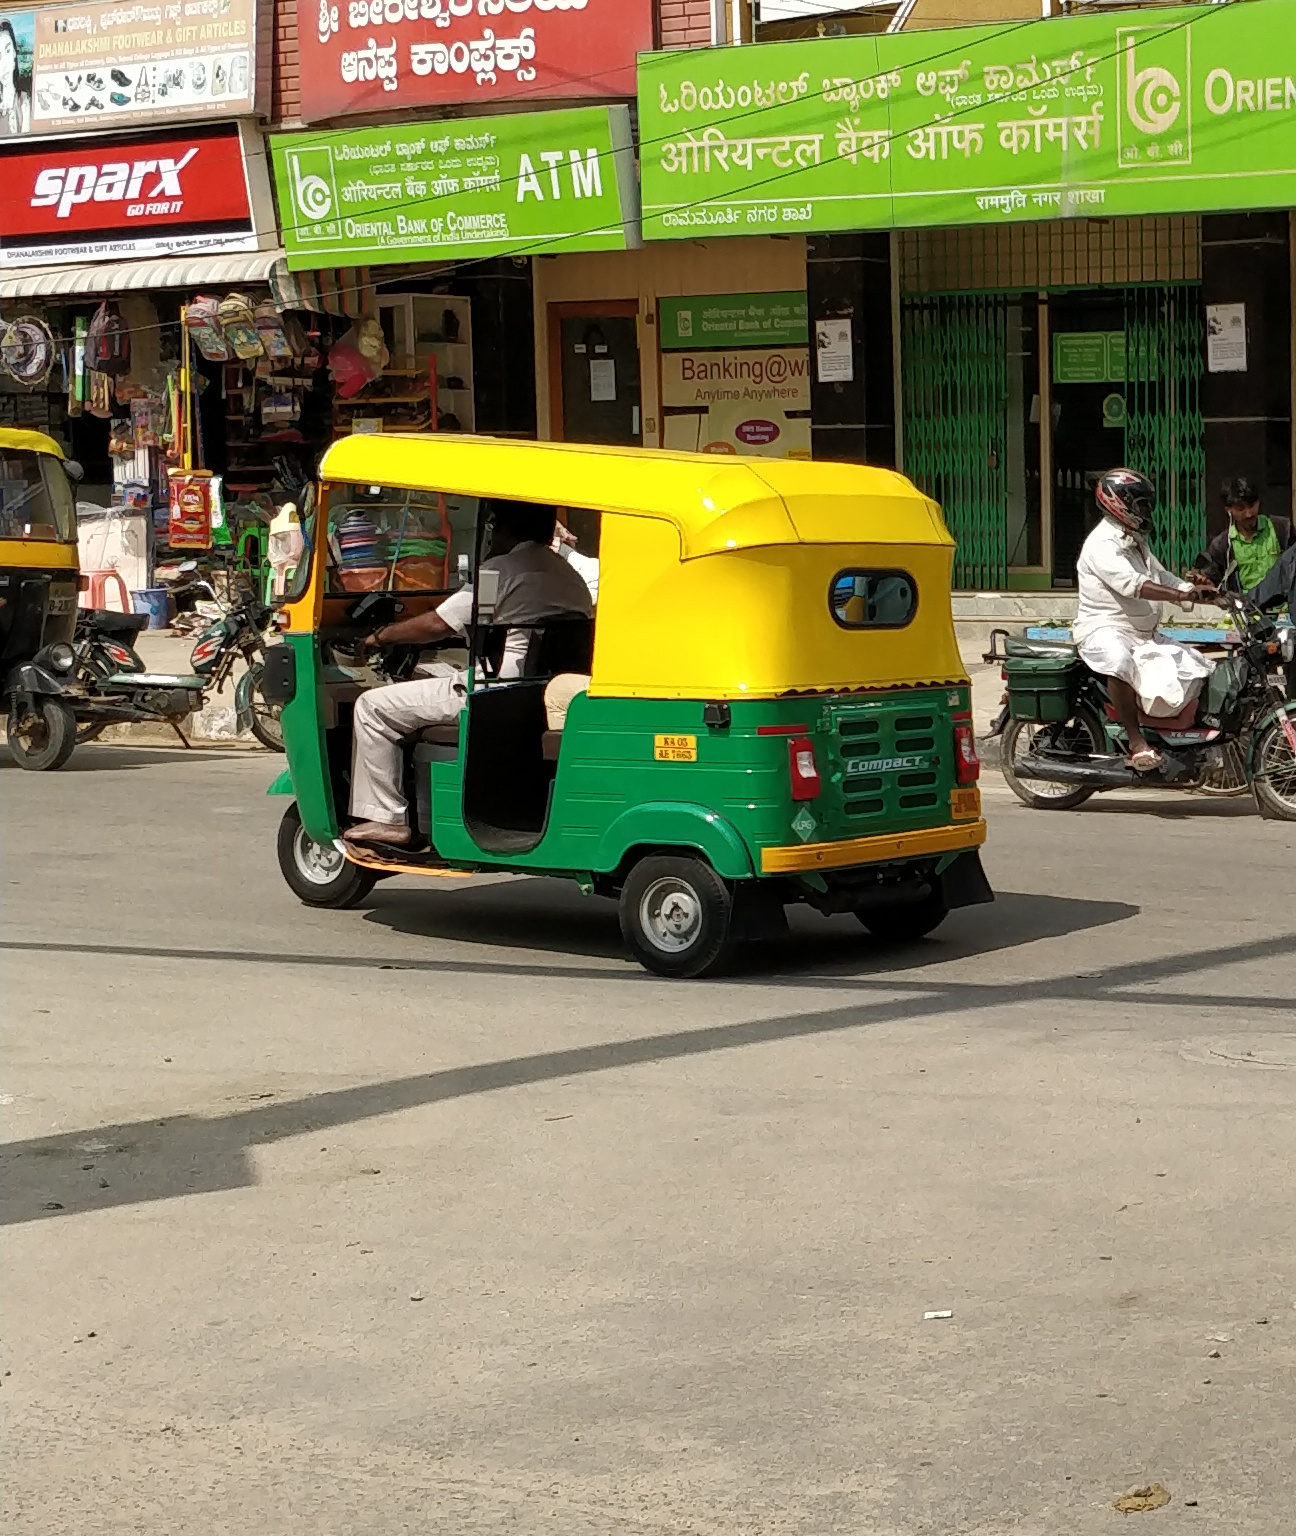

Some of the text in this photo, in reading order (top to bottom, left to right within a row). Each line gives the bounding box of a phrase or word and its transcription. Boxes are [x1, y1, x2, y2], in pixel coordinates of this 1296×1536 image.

[39, 20, 246, 59] DHANALAKSHMI FOOTWEAR & GIFT ARTICLES
[660, 101, 1104, 174] ओरियन्टल बैंक ऑफ कॉमर्स
[31, 147, 199, 218] sparx
[341, 180, 402, 203] ओरियन्टल
[405, 175, 427, 198] बैंक
[517, 147, 603, 203] ATM
[126, 201, 183, 216] GO FOR IT
[344, 211, 508, 239] ORIENTAL BANK OF COMMERCE
[695, 386, 799, 403] Anytime Anywhere
